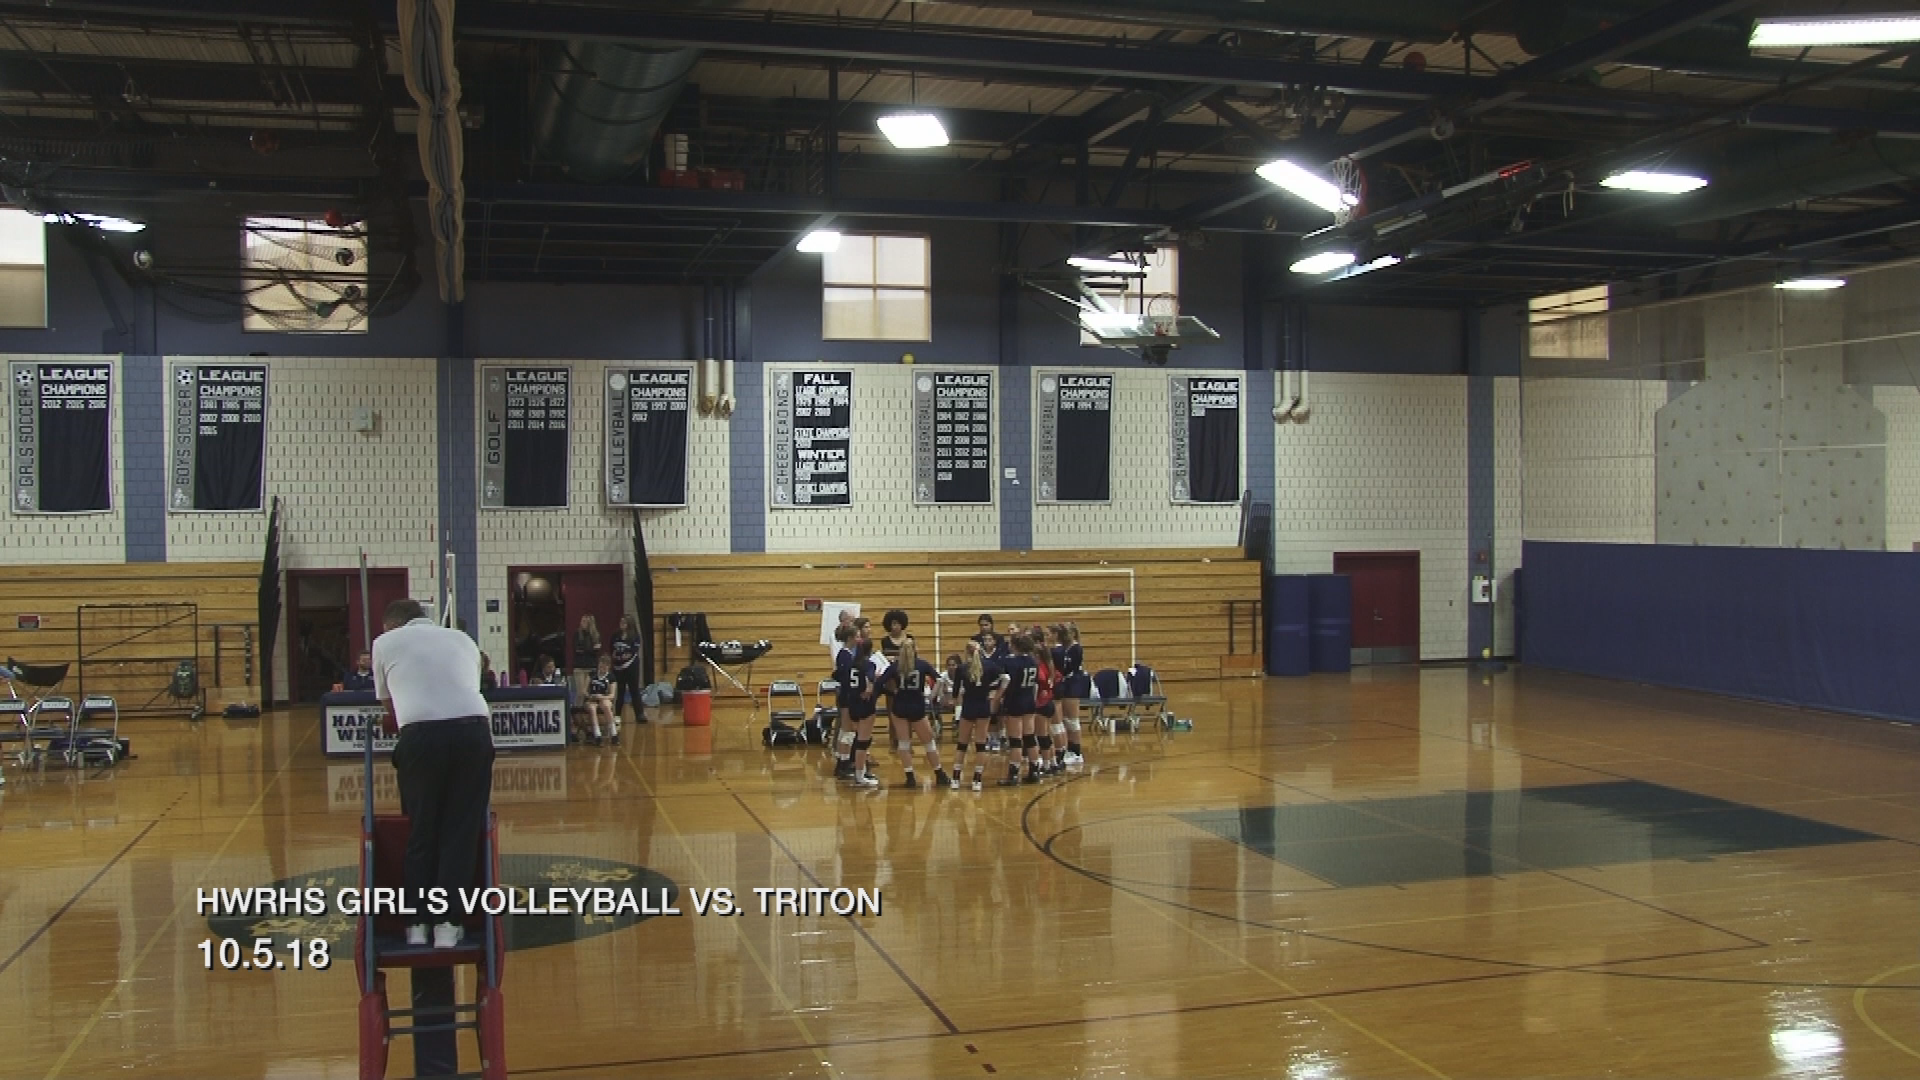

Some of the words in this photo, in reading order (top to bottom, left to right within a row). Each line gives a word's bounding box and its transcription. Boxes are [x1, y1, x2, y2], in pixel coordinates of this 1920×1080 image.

[39, 368, 108, 380] LEAGUE
[198, 369, 264, 382] LEAGUE
[506, 371, 568, 382] LEAGUE
[629, 374, 689, 384] LEAGUE
[803, 373, 841, 385] FALL
[936, 375, 989, 386] LEAGUE
[1059, 377, 1111, 388] LEAGUE
[1190, 381, 1239, 392] LEAGUE
[41, 383, 107, 395] CHAMPIONS
[199, 385, 262, 398] CHAMPIONS
[507, 384, 567, 395] CHAMPIONS
[631, 387, 688, 398] CHAMPIONS
[936, 387, 989, 398] CHAMPIONS
[1060, 389, 1110, 400] CHAMPIONS
[1191, 393, 1238, 405] CHAMPIONS
[18, 389, 34, 443] SOCCER
[177, 388, 193, 444] SOCCER
[487, 409, 501, 466] GOLF
[611, 391, 625, 485] VOLLEYBALL
[775, 389, 790, 485] CHEERLEADING
[1174, 401, 1187, 477] GYMNASTICS
[797, 449, 846, 460] WINTER
[18, 448, 34, 487] GIRLS
[176, 449, 191, 485] BOYS
[849, 667, 860, 688] 5
[899, 669, 920, 690] 13
[1021, 667, 1038, 688] 12
[491, 709, 561, 736] GENERALS
